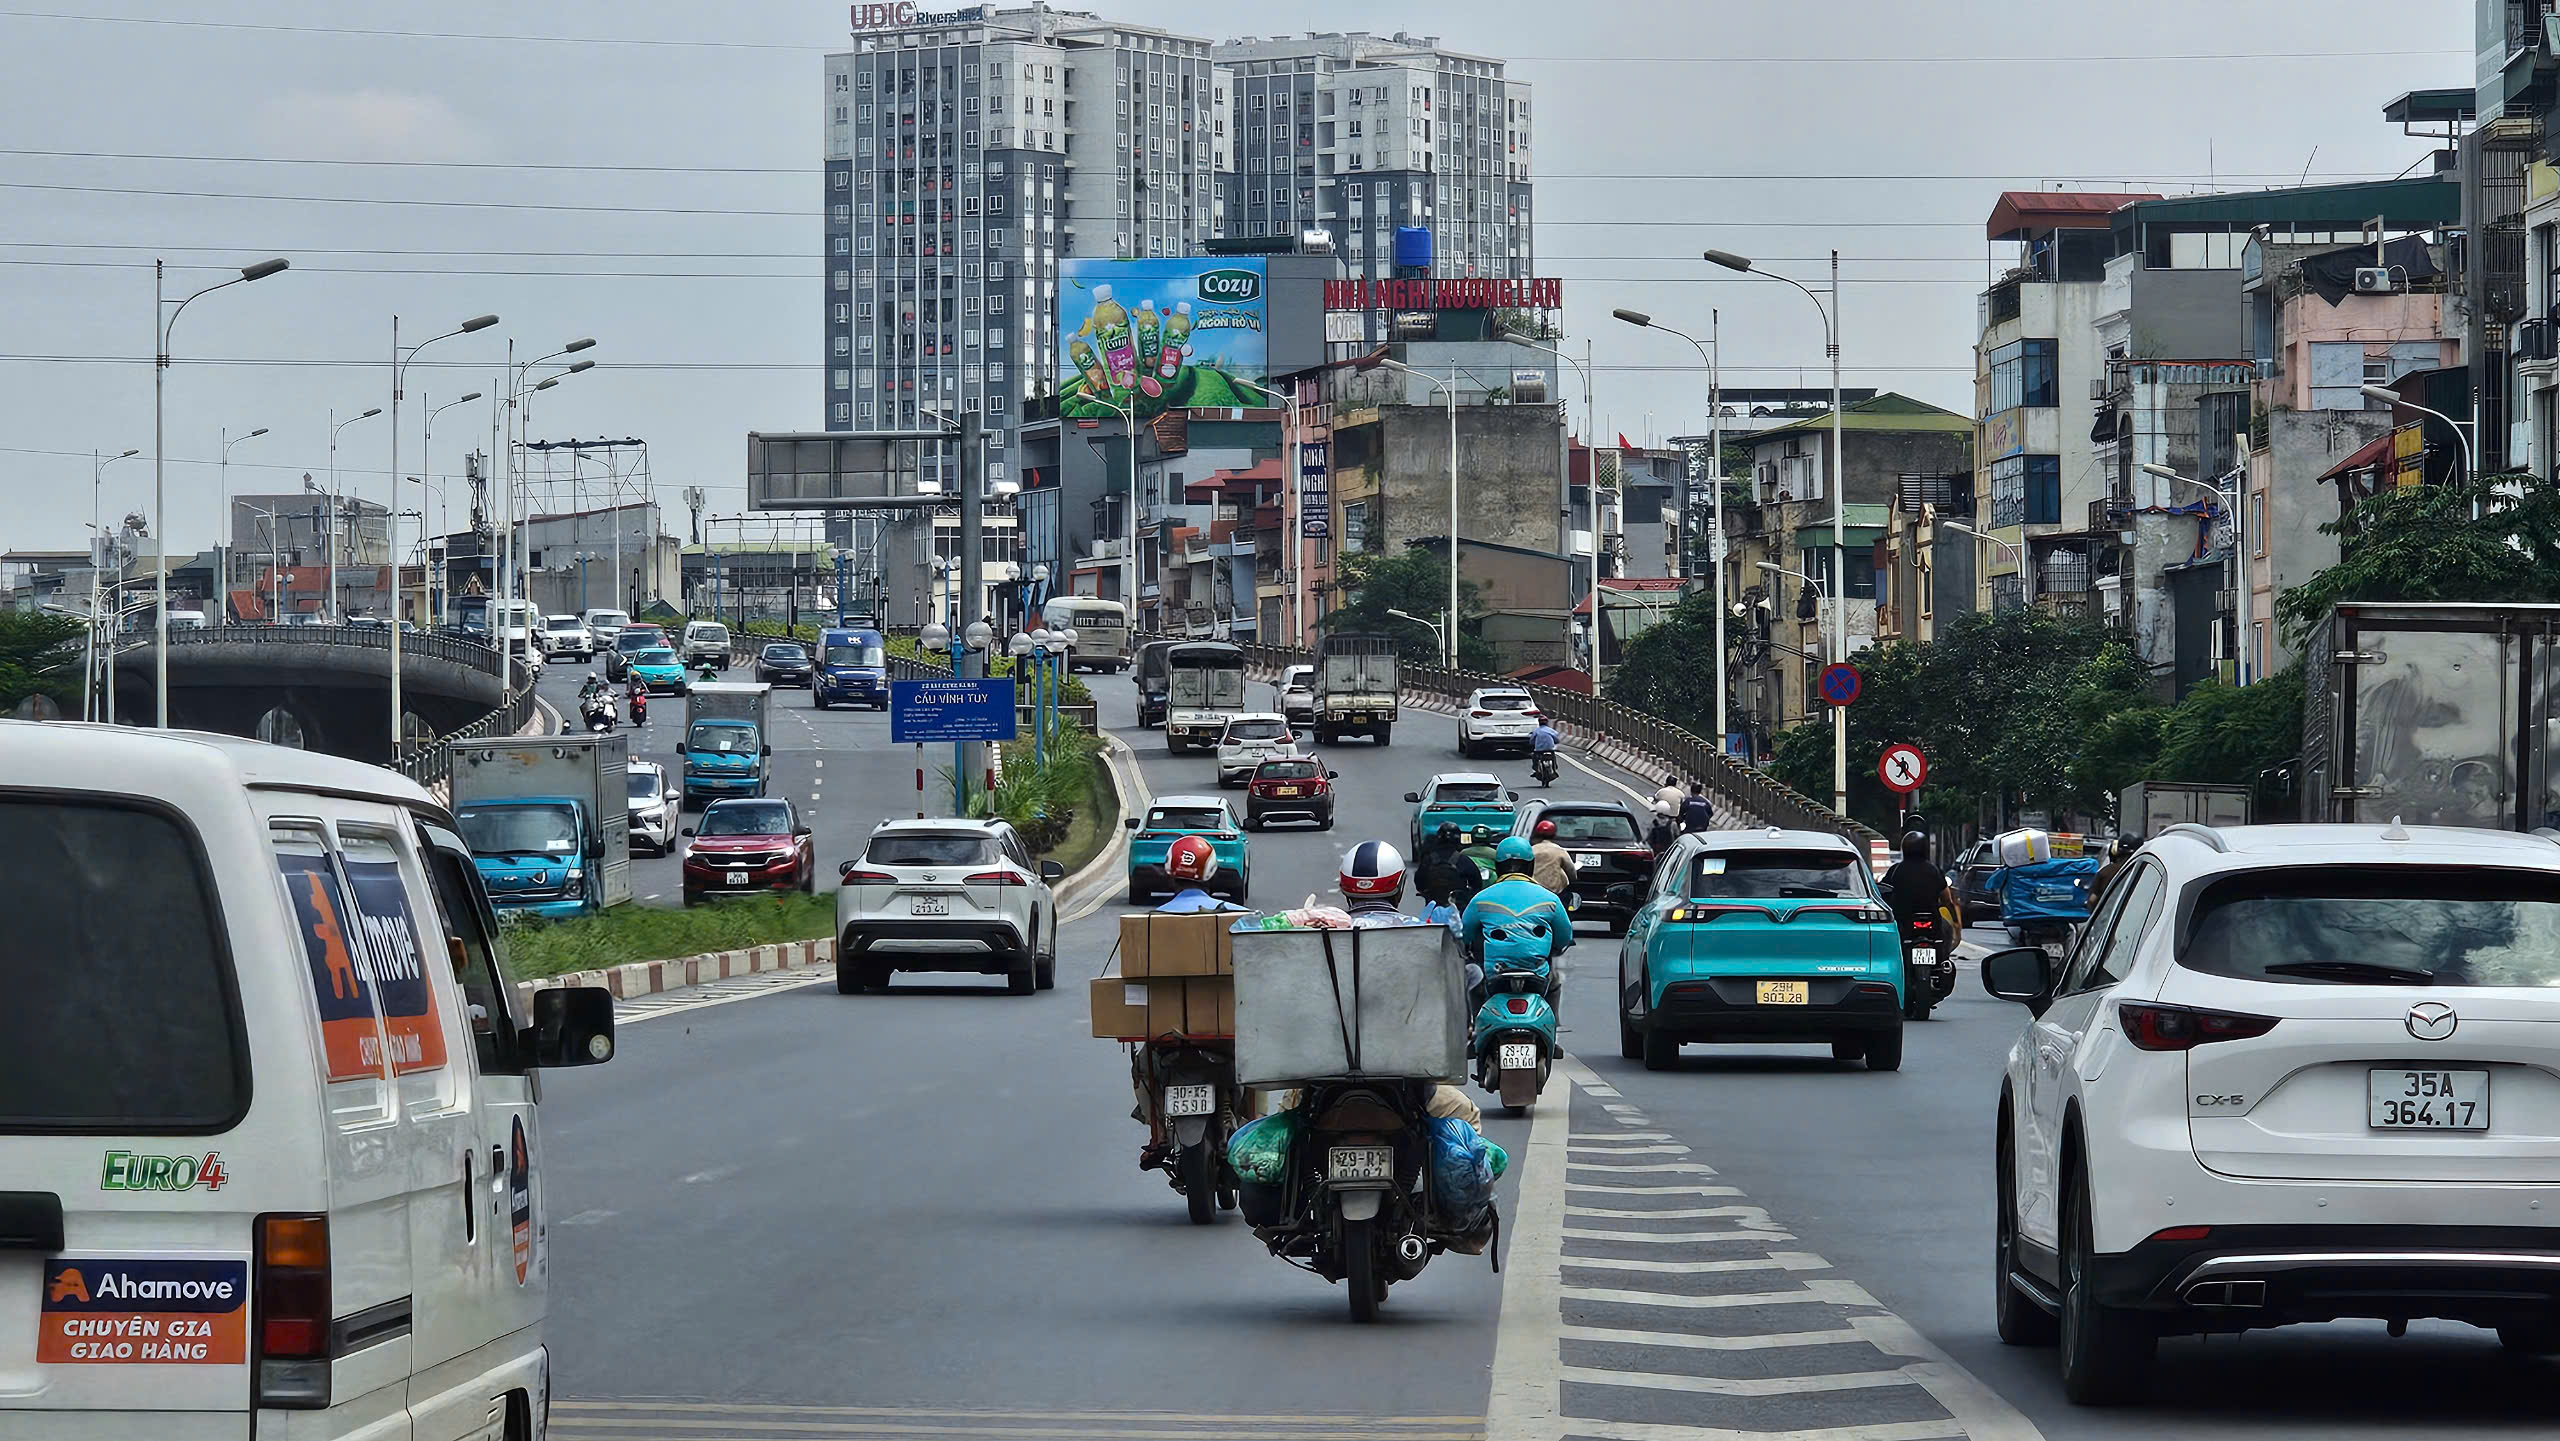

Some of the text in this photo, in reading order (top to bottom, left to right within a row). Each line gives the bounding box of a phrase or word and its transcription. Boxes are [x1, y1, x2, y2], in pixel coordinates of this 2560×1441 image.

[851, 2, 914, 29] UDIC
[1204, 275, 1253, 297] Cozy
[1325, 274, 1369, 309] NHÀ
[1518, 278, 1562, 308] LAN
[1303, 445, 1326, 467] NHÀ
[967, 693, 988, 703] TUY
[1763, 993, 1803, 1003] 903.28
[2404, 1072, 2454, 1098] 35A
[2383, 1100, 2477, 1126] 364.17
[96, 1273, 233, 1299] Ahamove
[63, 1315, 212, 1337] CHUYÊN GIA
[70, 1338, 208, 1360] GIAO HÀNG
